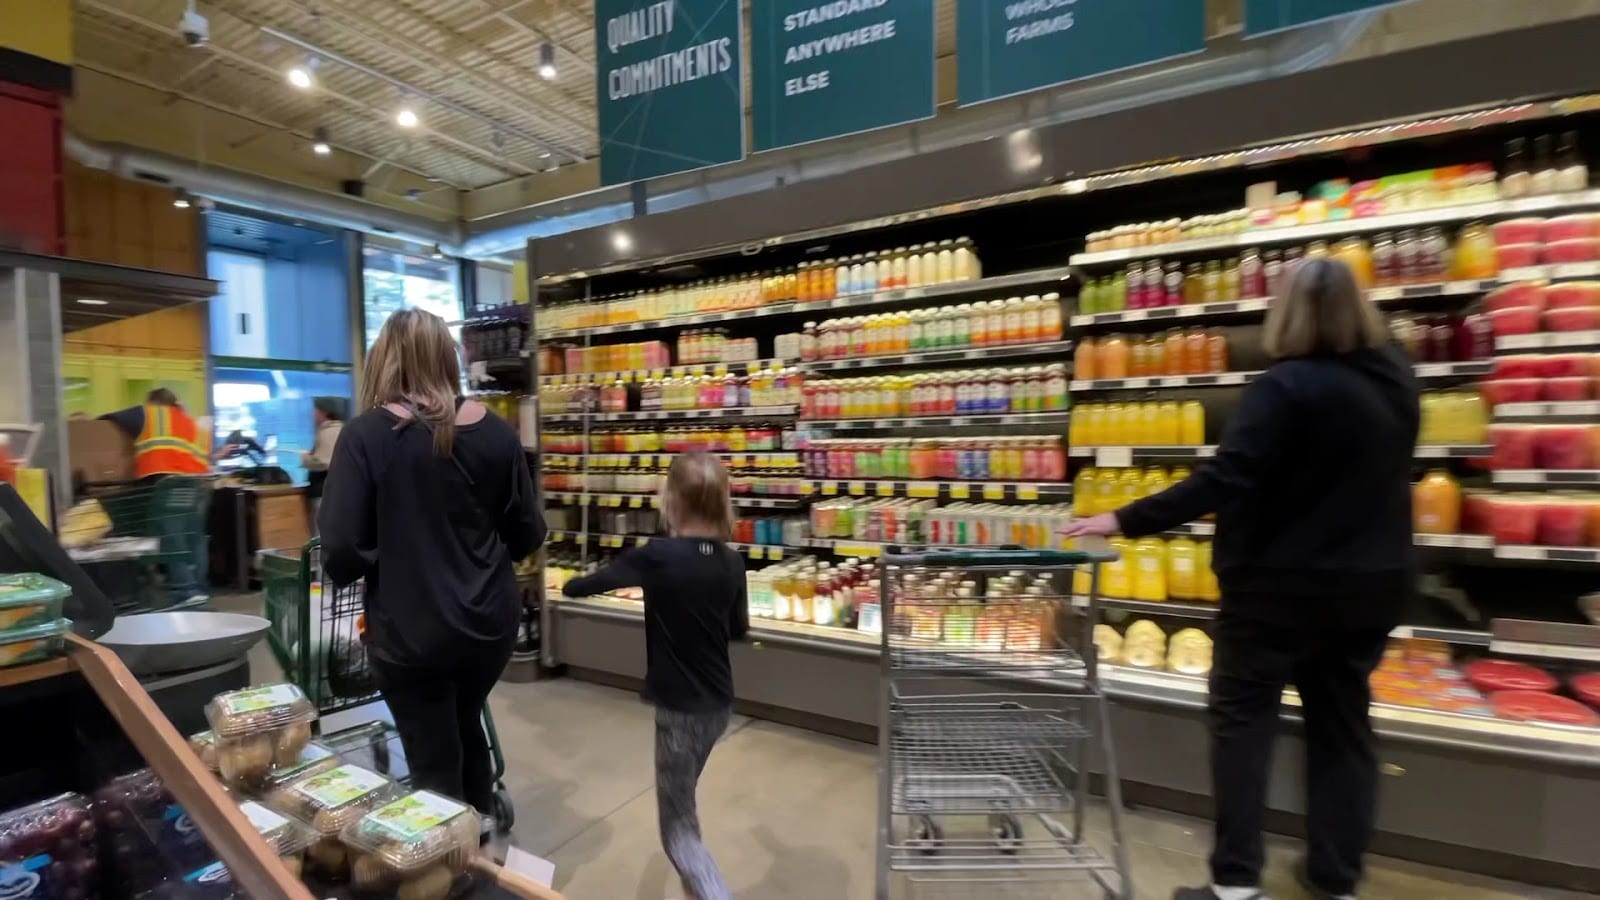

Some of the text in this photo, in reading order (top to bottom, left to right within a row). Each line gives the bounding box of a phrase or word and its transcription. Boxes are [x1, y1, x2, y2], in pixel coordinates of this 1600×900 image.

[607, 0, 675, 53] QUALITY
[784, 20, 897, 64] ANYWHERE
[1005, 11, 1074, 45] FARMS
[608, 37, 732, 101] COMMITMENTS
[784, 70, 830, 96] ELSE
